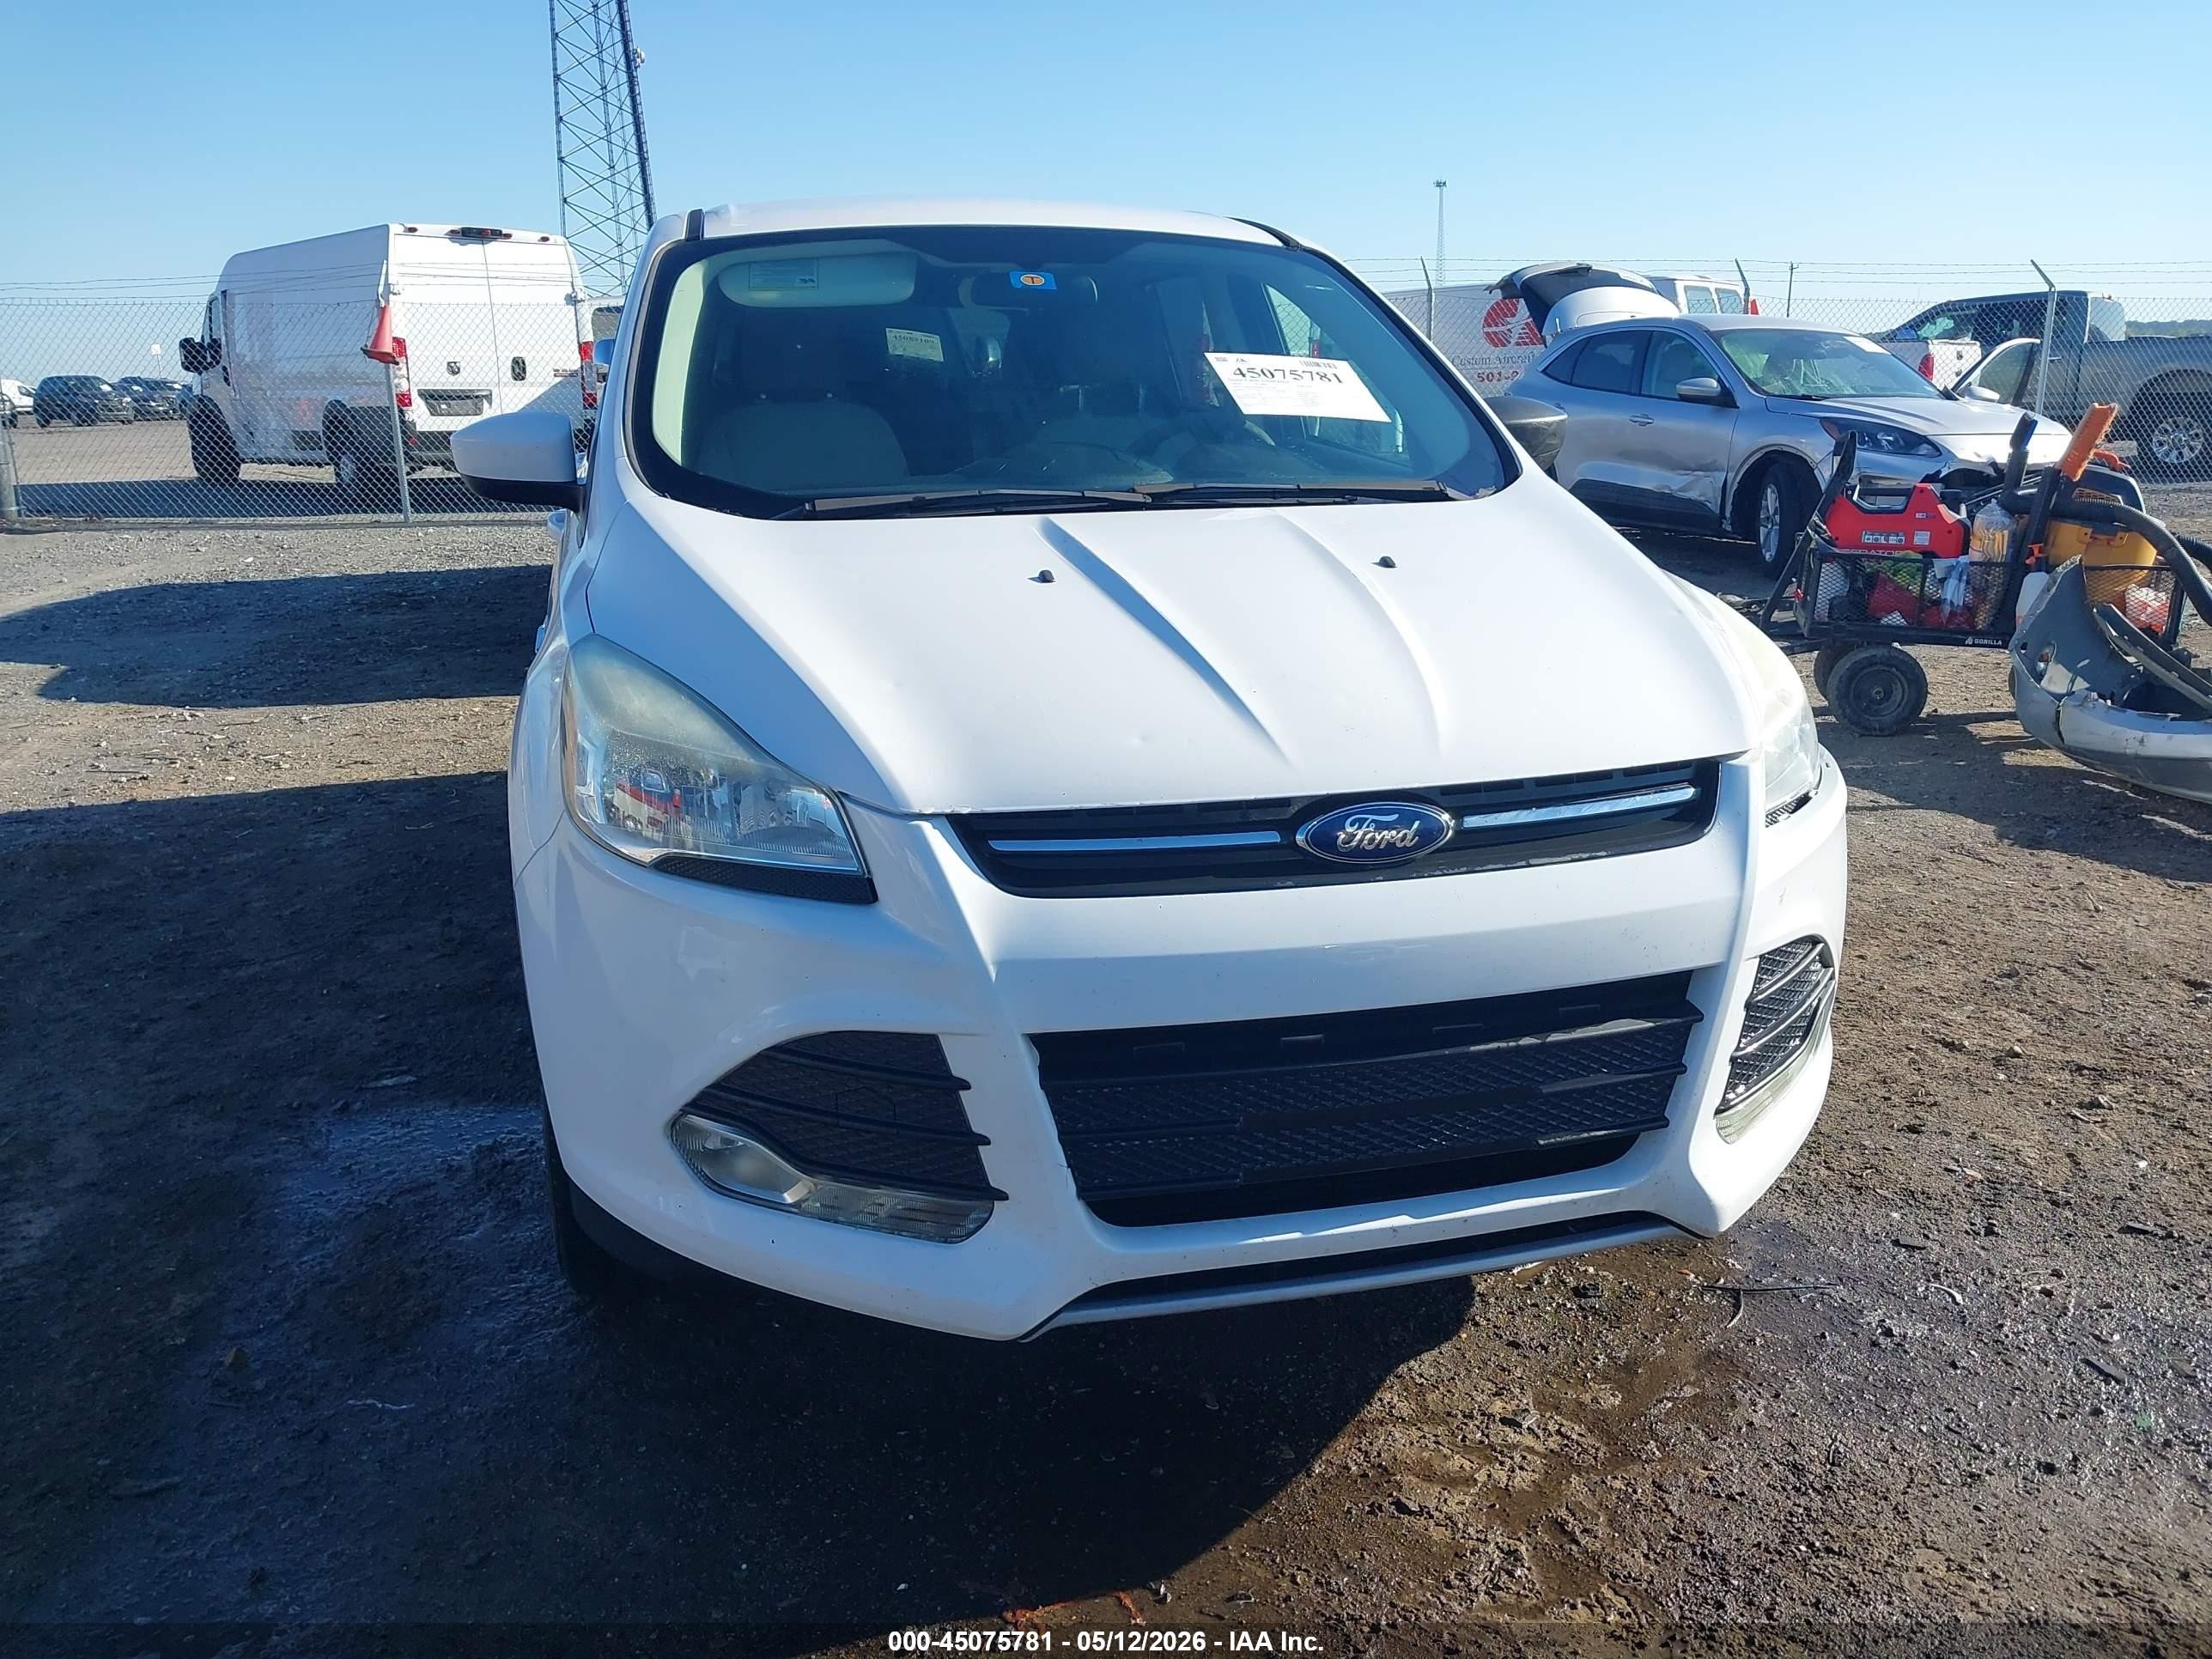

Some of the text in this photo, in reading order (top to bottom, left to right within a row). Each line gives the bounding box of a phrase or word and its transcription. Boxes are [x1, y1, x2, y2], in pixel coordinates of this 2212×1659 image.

[1451, 350, 1535, 366] Custom Aircraf
[1232, 367, 1344, 384] 45075781
[1336, 813, 1420, 853] Ford
